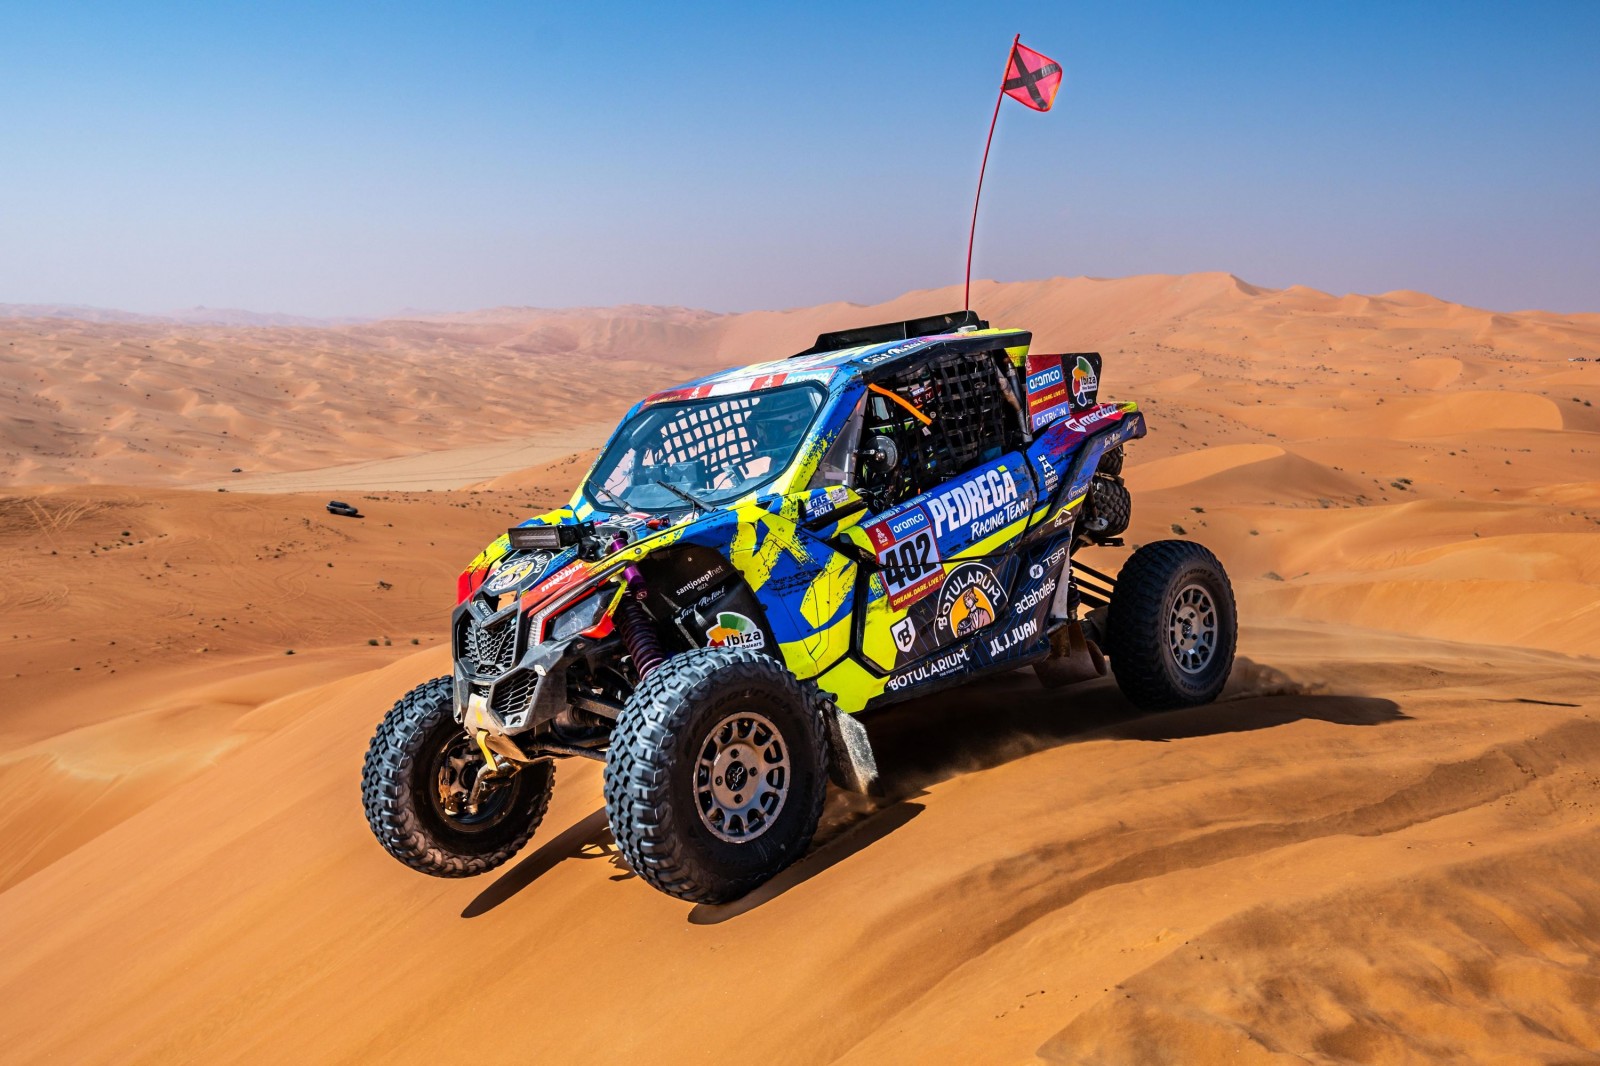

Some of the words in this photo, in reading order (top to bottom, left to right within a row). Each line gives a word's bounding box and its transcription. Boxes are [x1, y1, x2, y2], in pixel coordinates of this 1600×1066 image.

[1029, 369, 1060, 390] aramco
[810, 495, 828, 510] GAS
[813, 503, 833, 518] ROLL
[893, 513, 925, 534] aramco
[970, 510, 1005, 541] RACING
[1003, 498, 1029, 523] TEAM
[885, 532, 937, 589] 402
[696, 583, 709, 592] IBIZA
[893, 590, 914, 606] DREAM.
[913, 582, 929, 595] DARE.
[928, 575, 942, 587] LIVE
[1014, 577, 1056, 614] actahotels
[726, 630, 762, 648] Ibiza
[887, 647, 971, 691] BOTULARIUM
